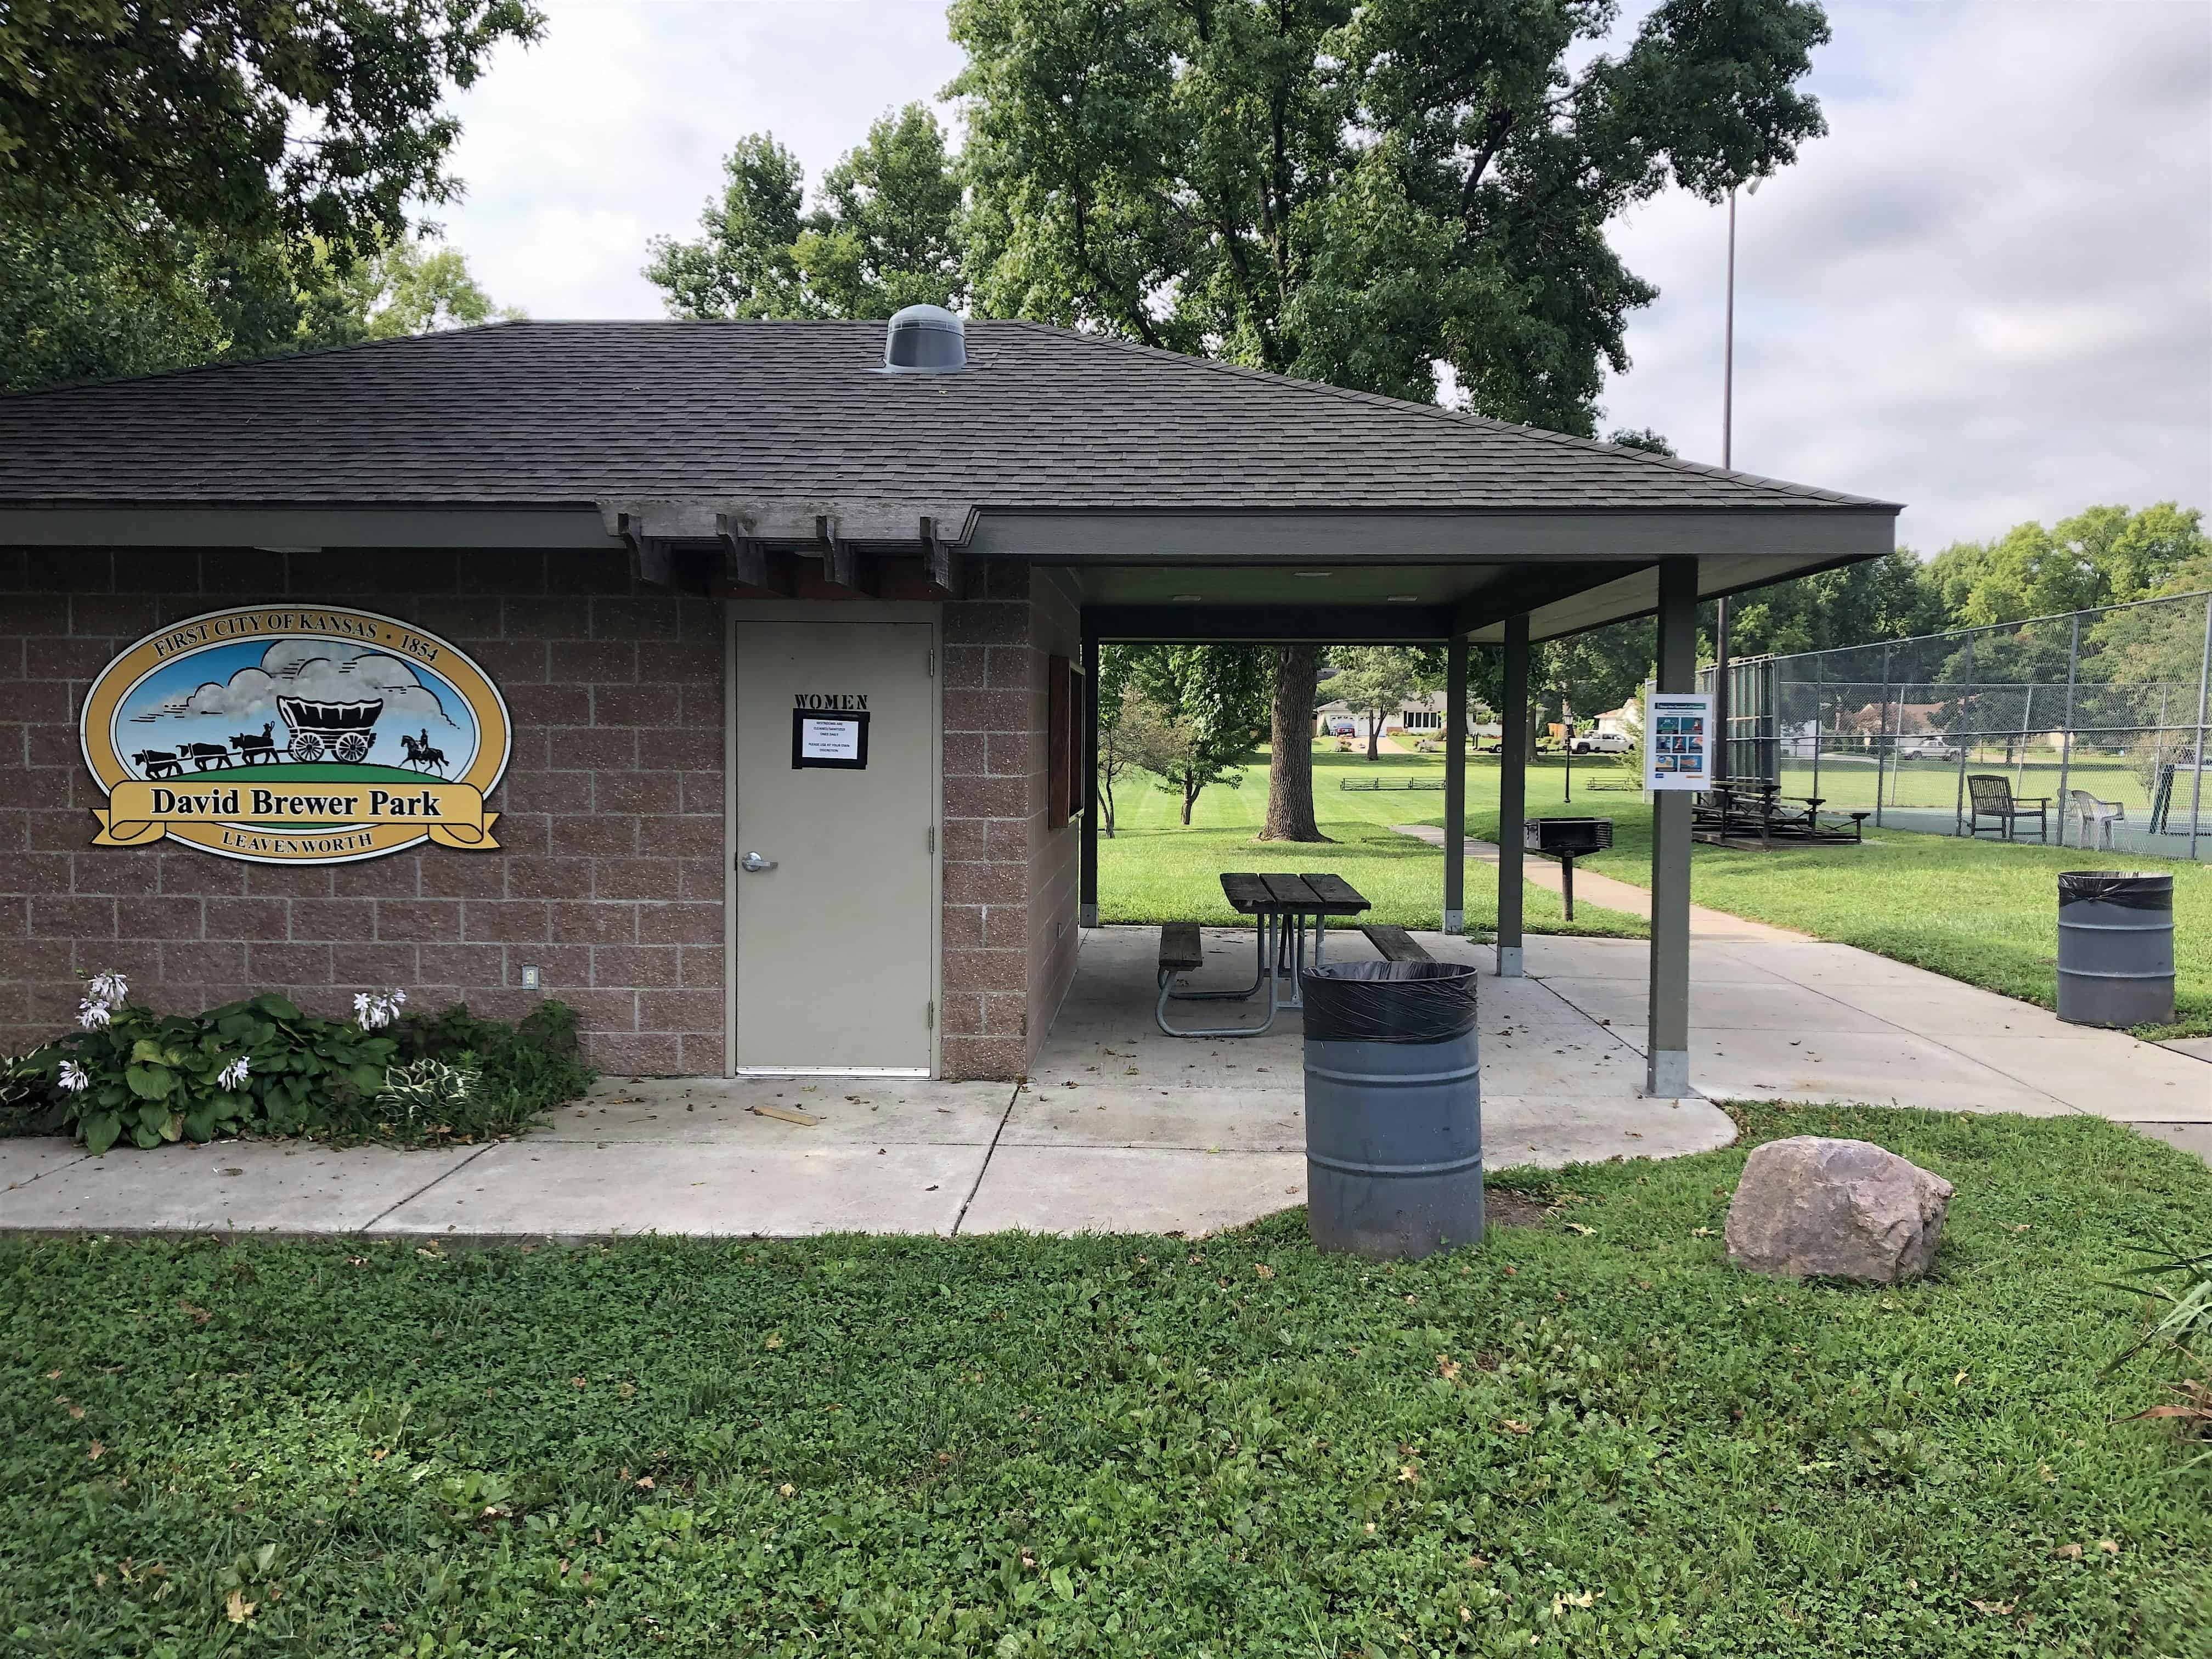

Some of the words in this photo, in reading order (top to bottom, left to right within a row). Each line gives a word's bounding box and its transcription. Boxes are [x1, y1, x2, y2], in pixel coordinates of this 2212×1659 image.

[153, 624, 208, 657] FIRST
[214, 615, 262, 636] CITY
[267, 613, 294, 630] OF
[300, 613, 378, 639] KANSAS
[401, 635, 438, 662] 1854
[794, 693, 868, 710] WOMEN
[151, 788, 241, 815] David
[250, 789, 358, 815] Brewer
[368, 790, 442, 816] Park
[222, 831, 373, 853] LEAVENWORTH
